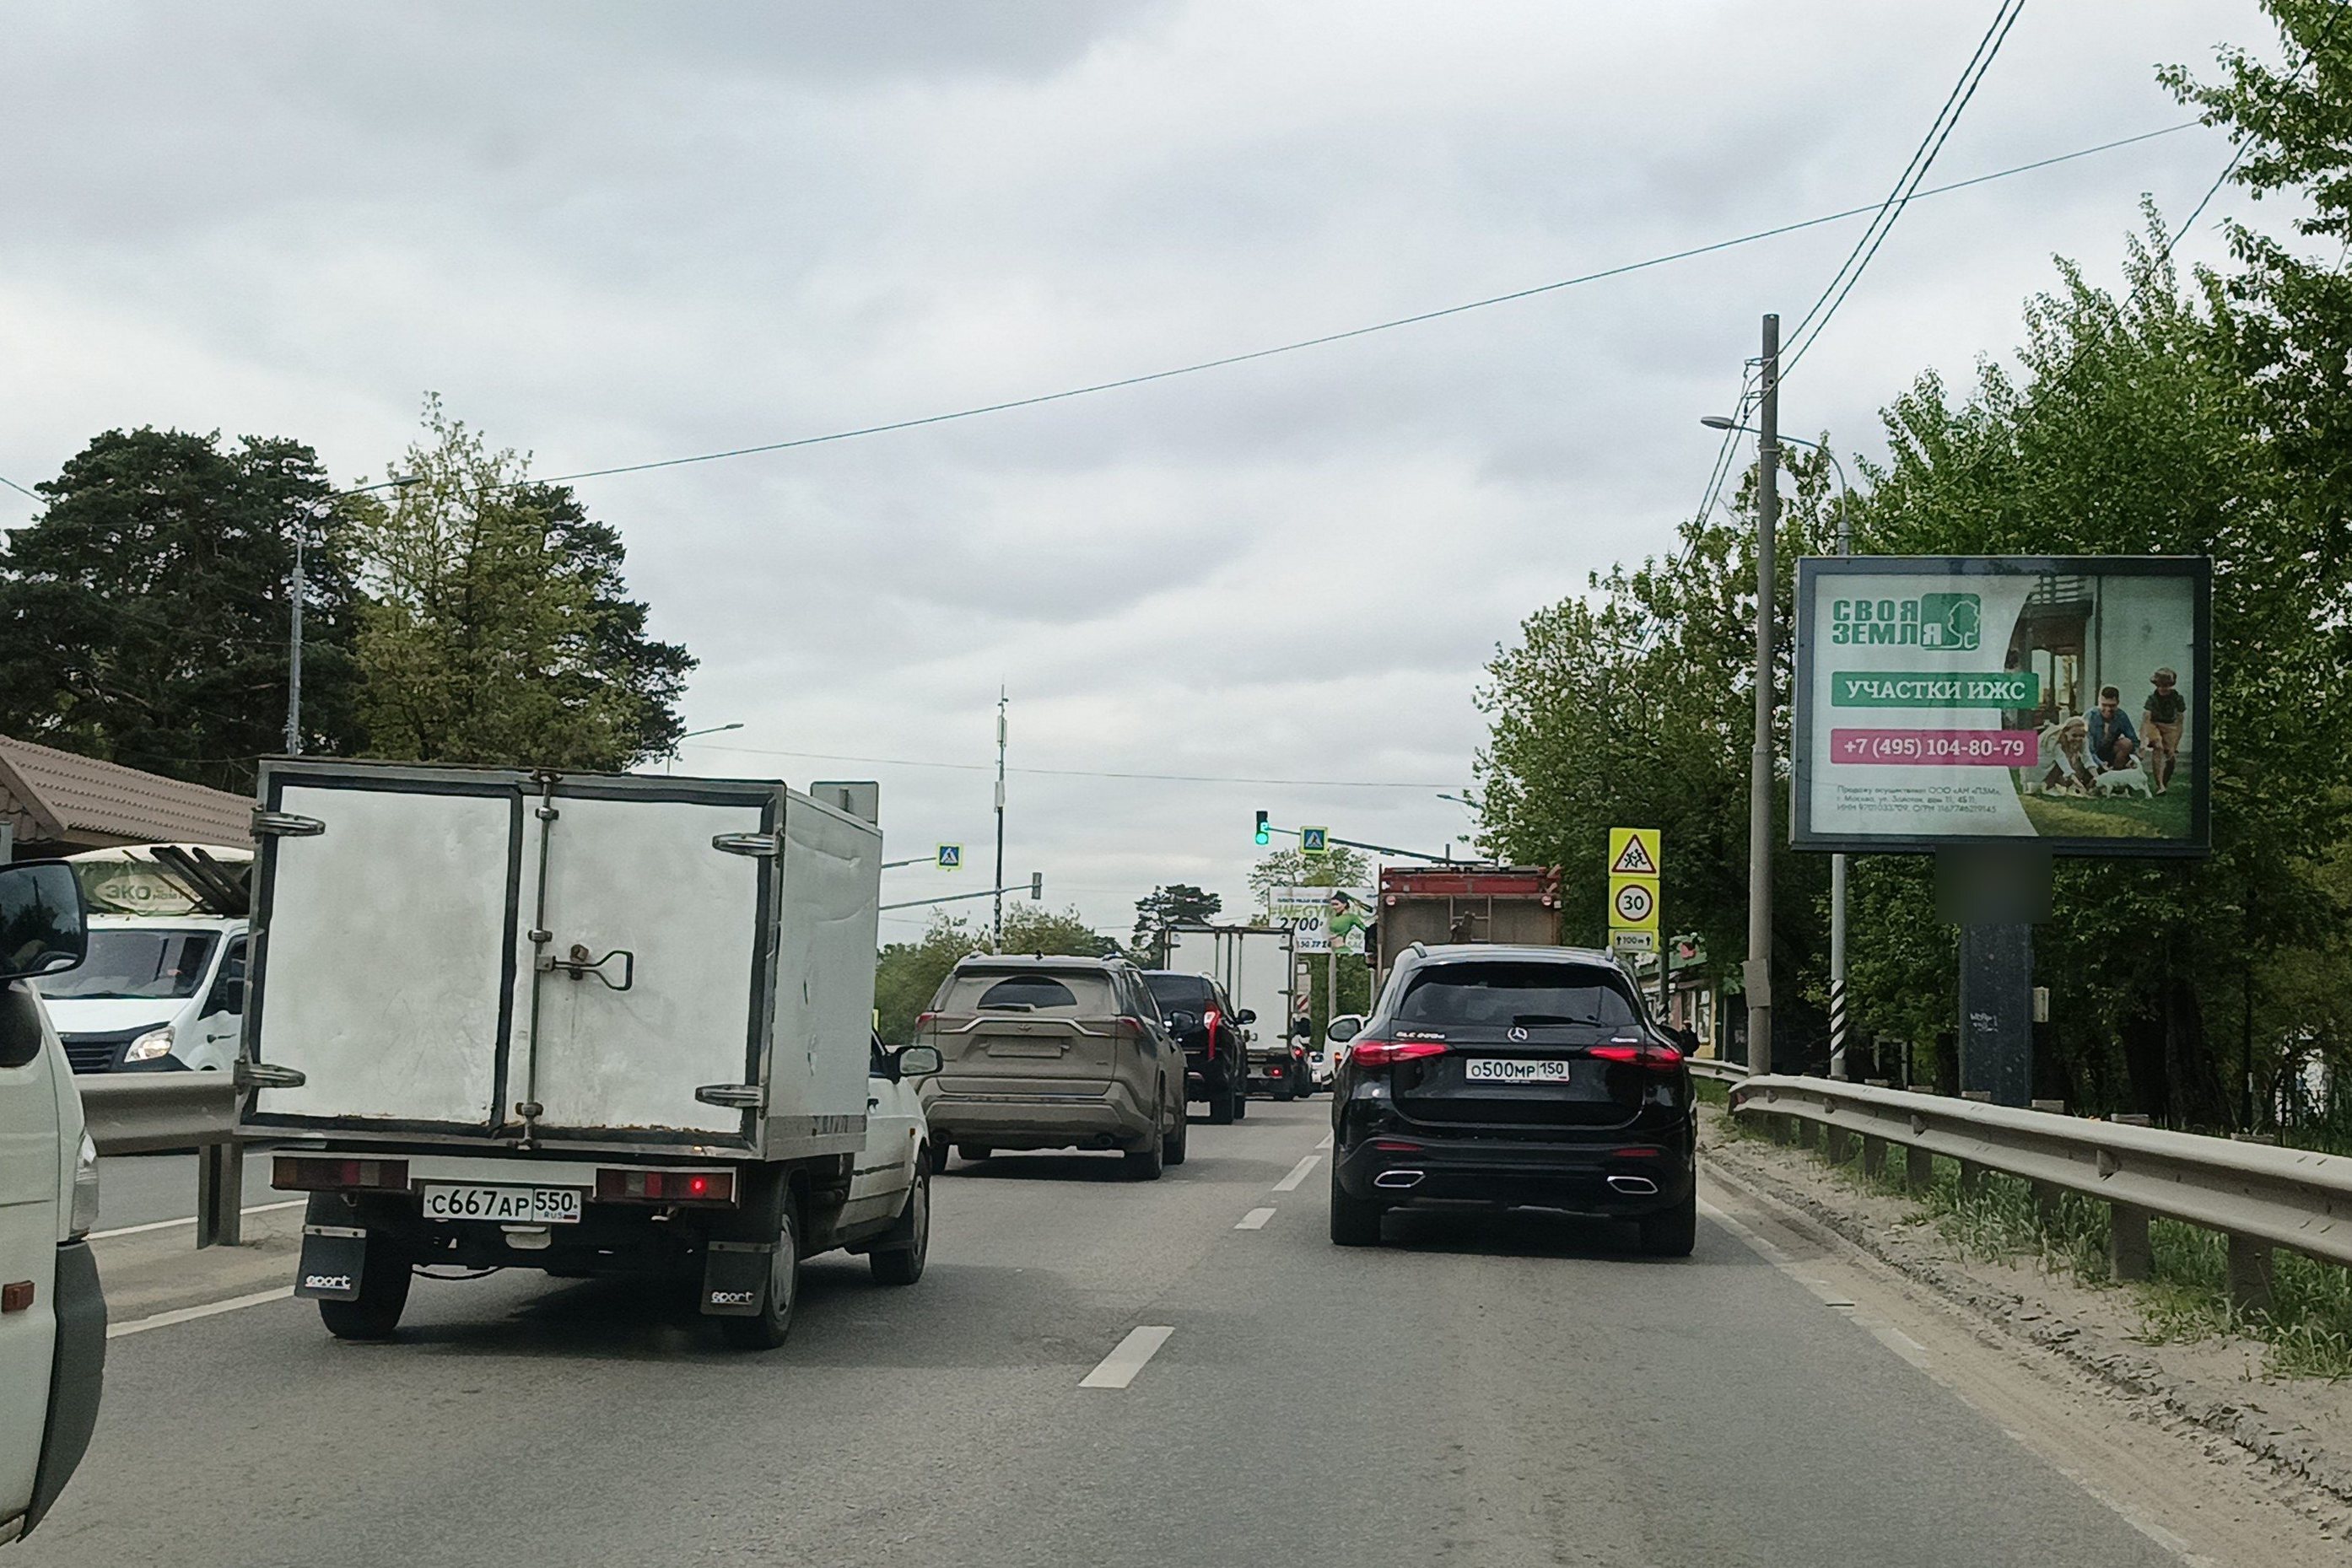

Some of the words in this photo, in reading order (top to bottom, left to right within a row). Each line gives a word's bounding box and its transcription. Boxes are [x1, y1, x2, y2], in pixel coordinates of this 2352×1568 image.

[1832, 600, 1918, 622] СВОЯ
[1831, 622, 1942, 645] ЗЕМЛЯ
[1845, 681, 1961, 700] УЧАСТКИ
[1966, 682, 2026, 701] ИЖС
[1844, 738, 1868, 754] +7
[1872, 738, 1923, 758] (495)
[1927, 739, 2025, 757] 104-80-79
[1928, 786, 1951, 795] ООО
[105, 885, 152, 900] ЭКО
[1623, 895, 1644, 911] 30
[1540, 1062, 1564, 1075] 150
[534, 1191, 574, 1211] 550
